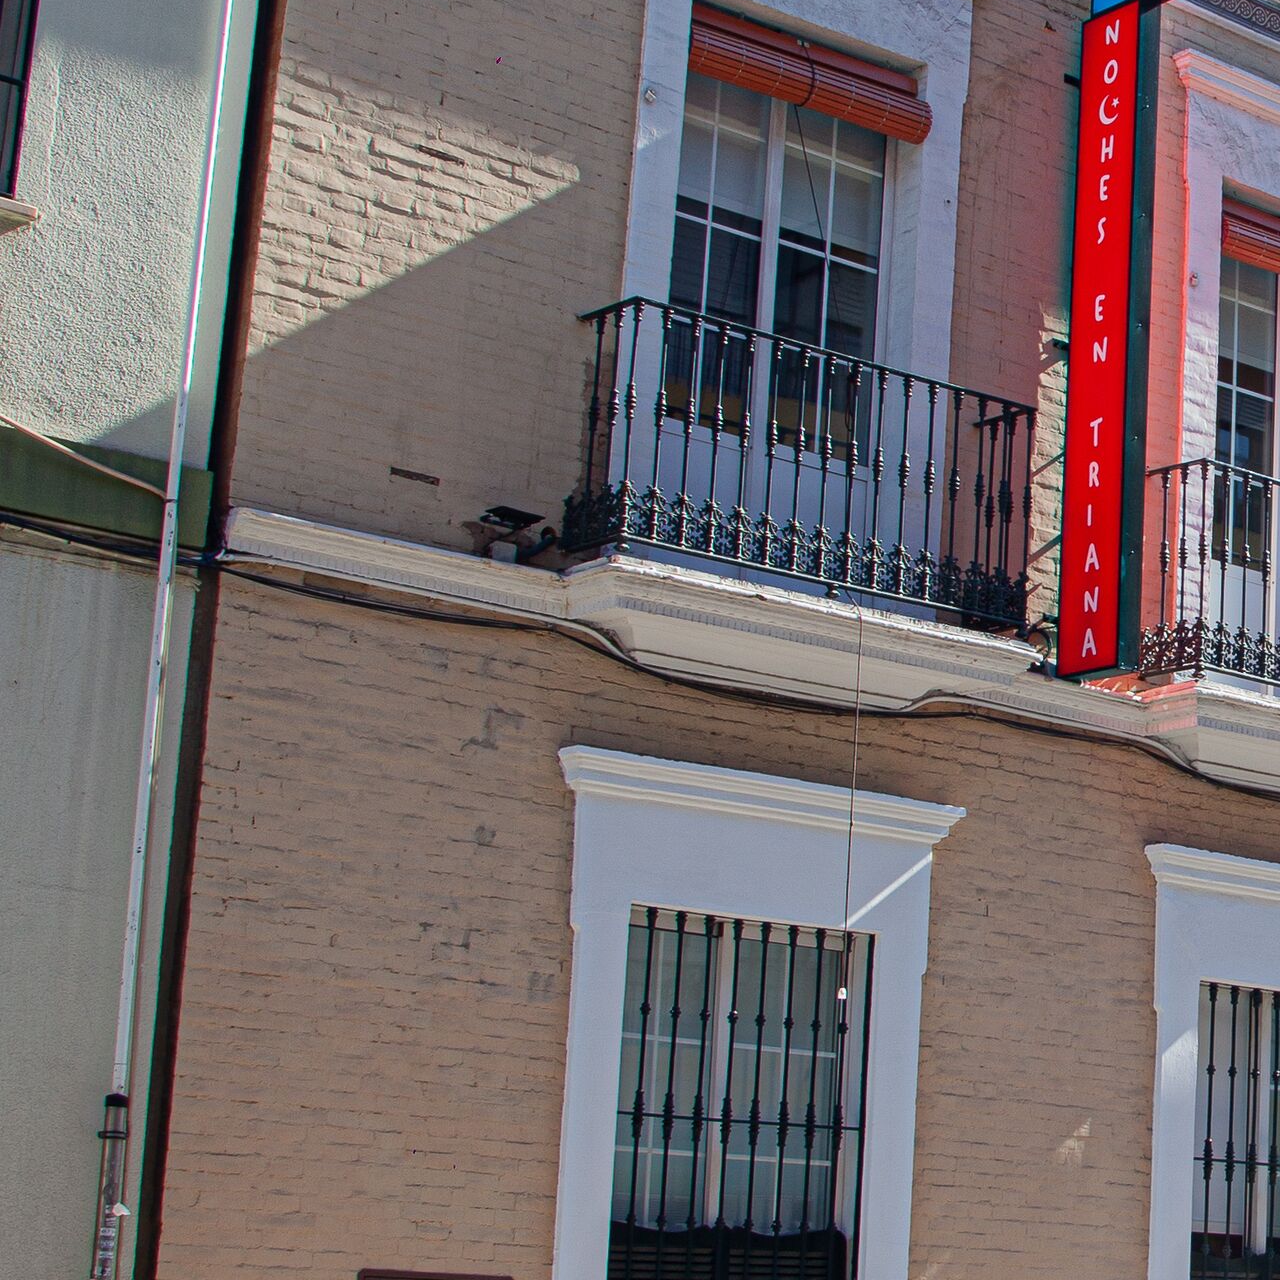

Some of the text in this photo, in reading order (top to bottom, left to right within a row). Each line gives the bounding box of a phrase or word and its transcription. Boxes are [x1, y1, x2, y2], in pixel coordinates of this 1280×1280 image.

[1081, 19, 1120, 659] NOCHES EN TRIANA
